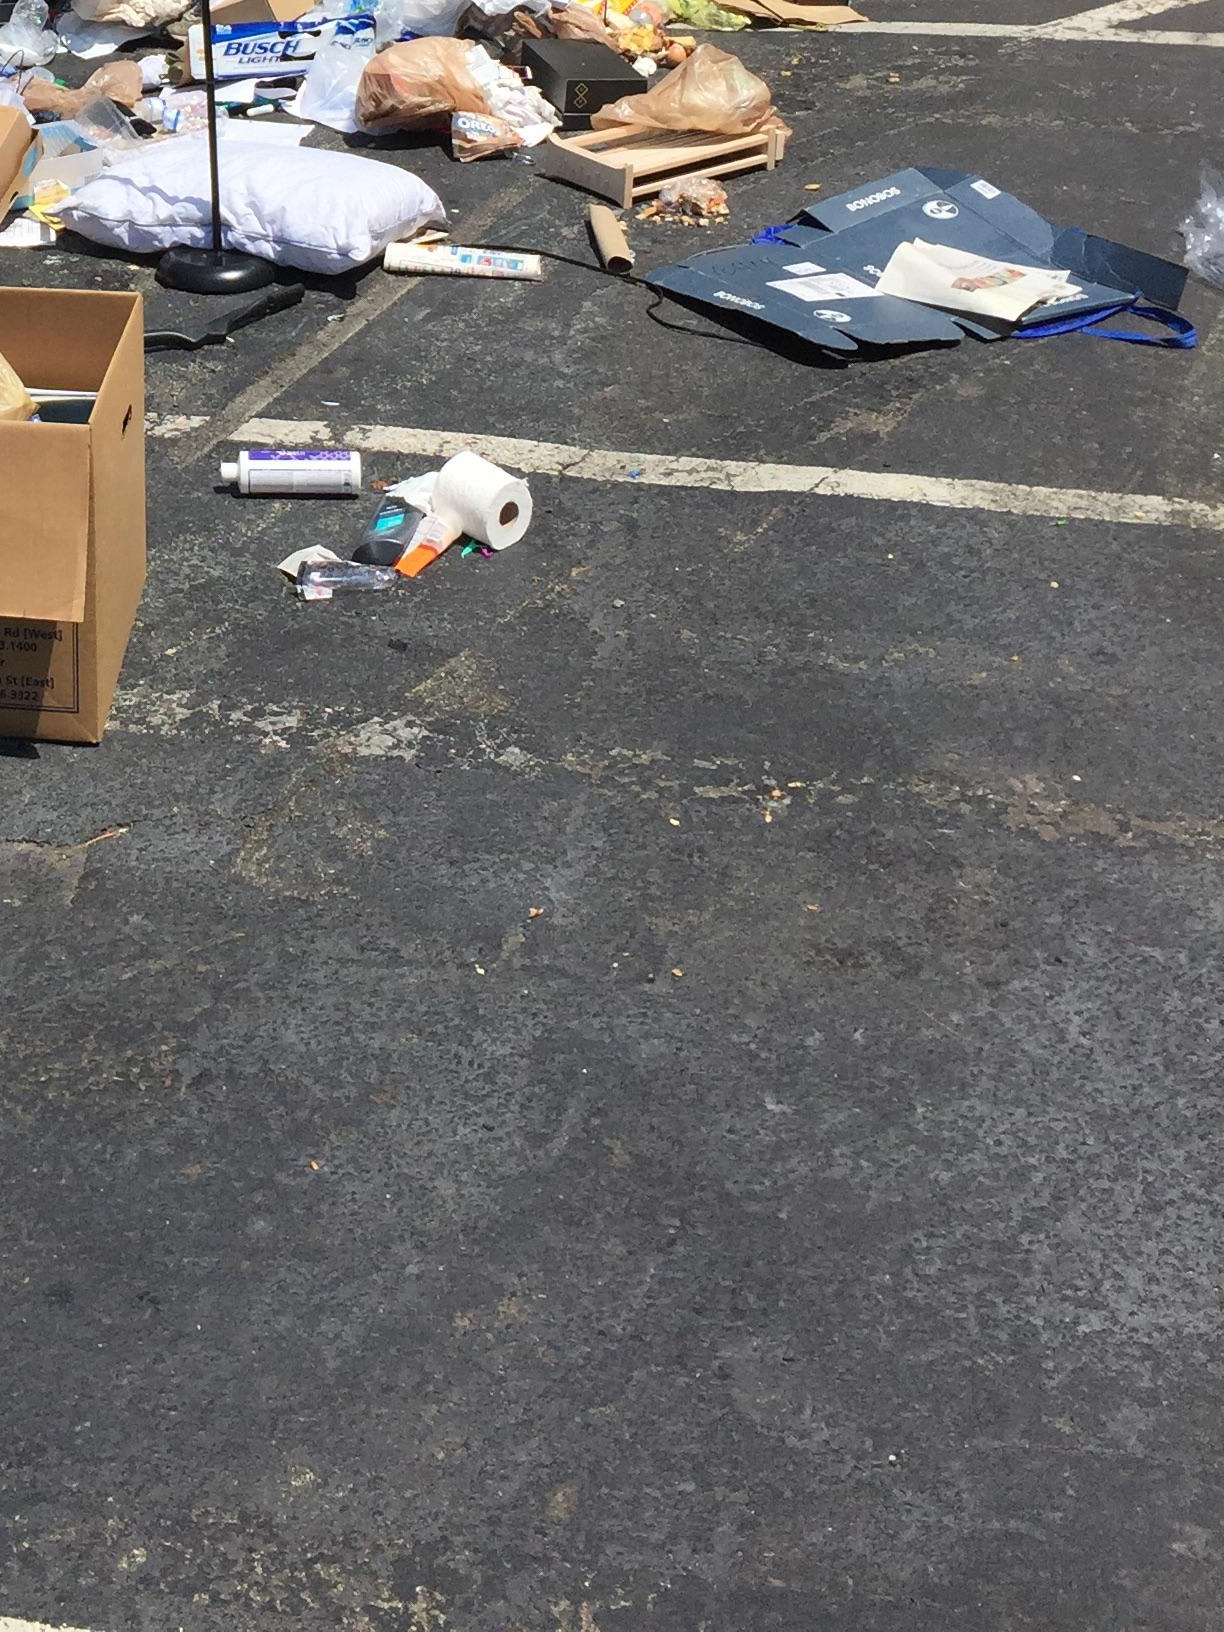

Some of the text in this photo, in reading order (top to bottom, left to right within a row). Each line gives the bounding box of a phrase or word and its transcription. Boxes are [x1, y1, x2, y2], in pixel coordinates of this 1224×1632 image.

[223, 40, 300, 57] BUSCH
[238, 56, 281, 65] LIGHT
[457, 117, 498, 134] OREO
[846, 186, 902, 212] BONOBOS
[4, 627, 20, 638] Rd
[23, 628, 63, 641] [West]
[6, 674, 18, 685] St
[21, 677, 55, 689] [East]
